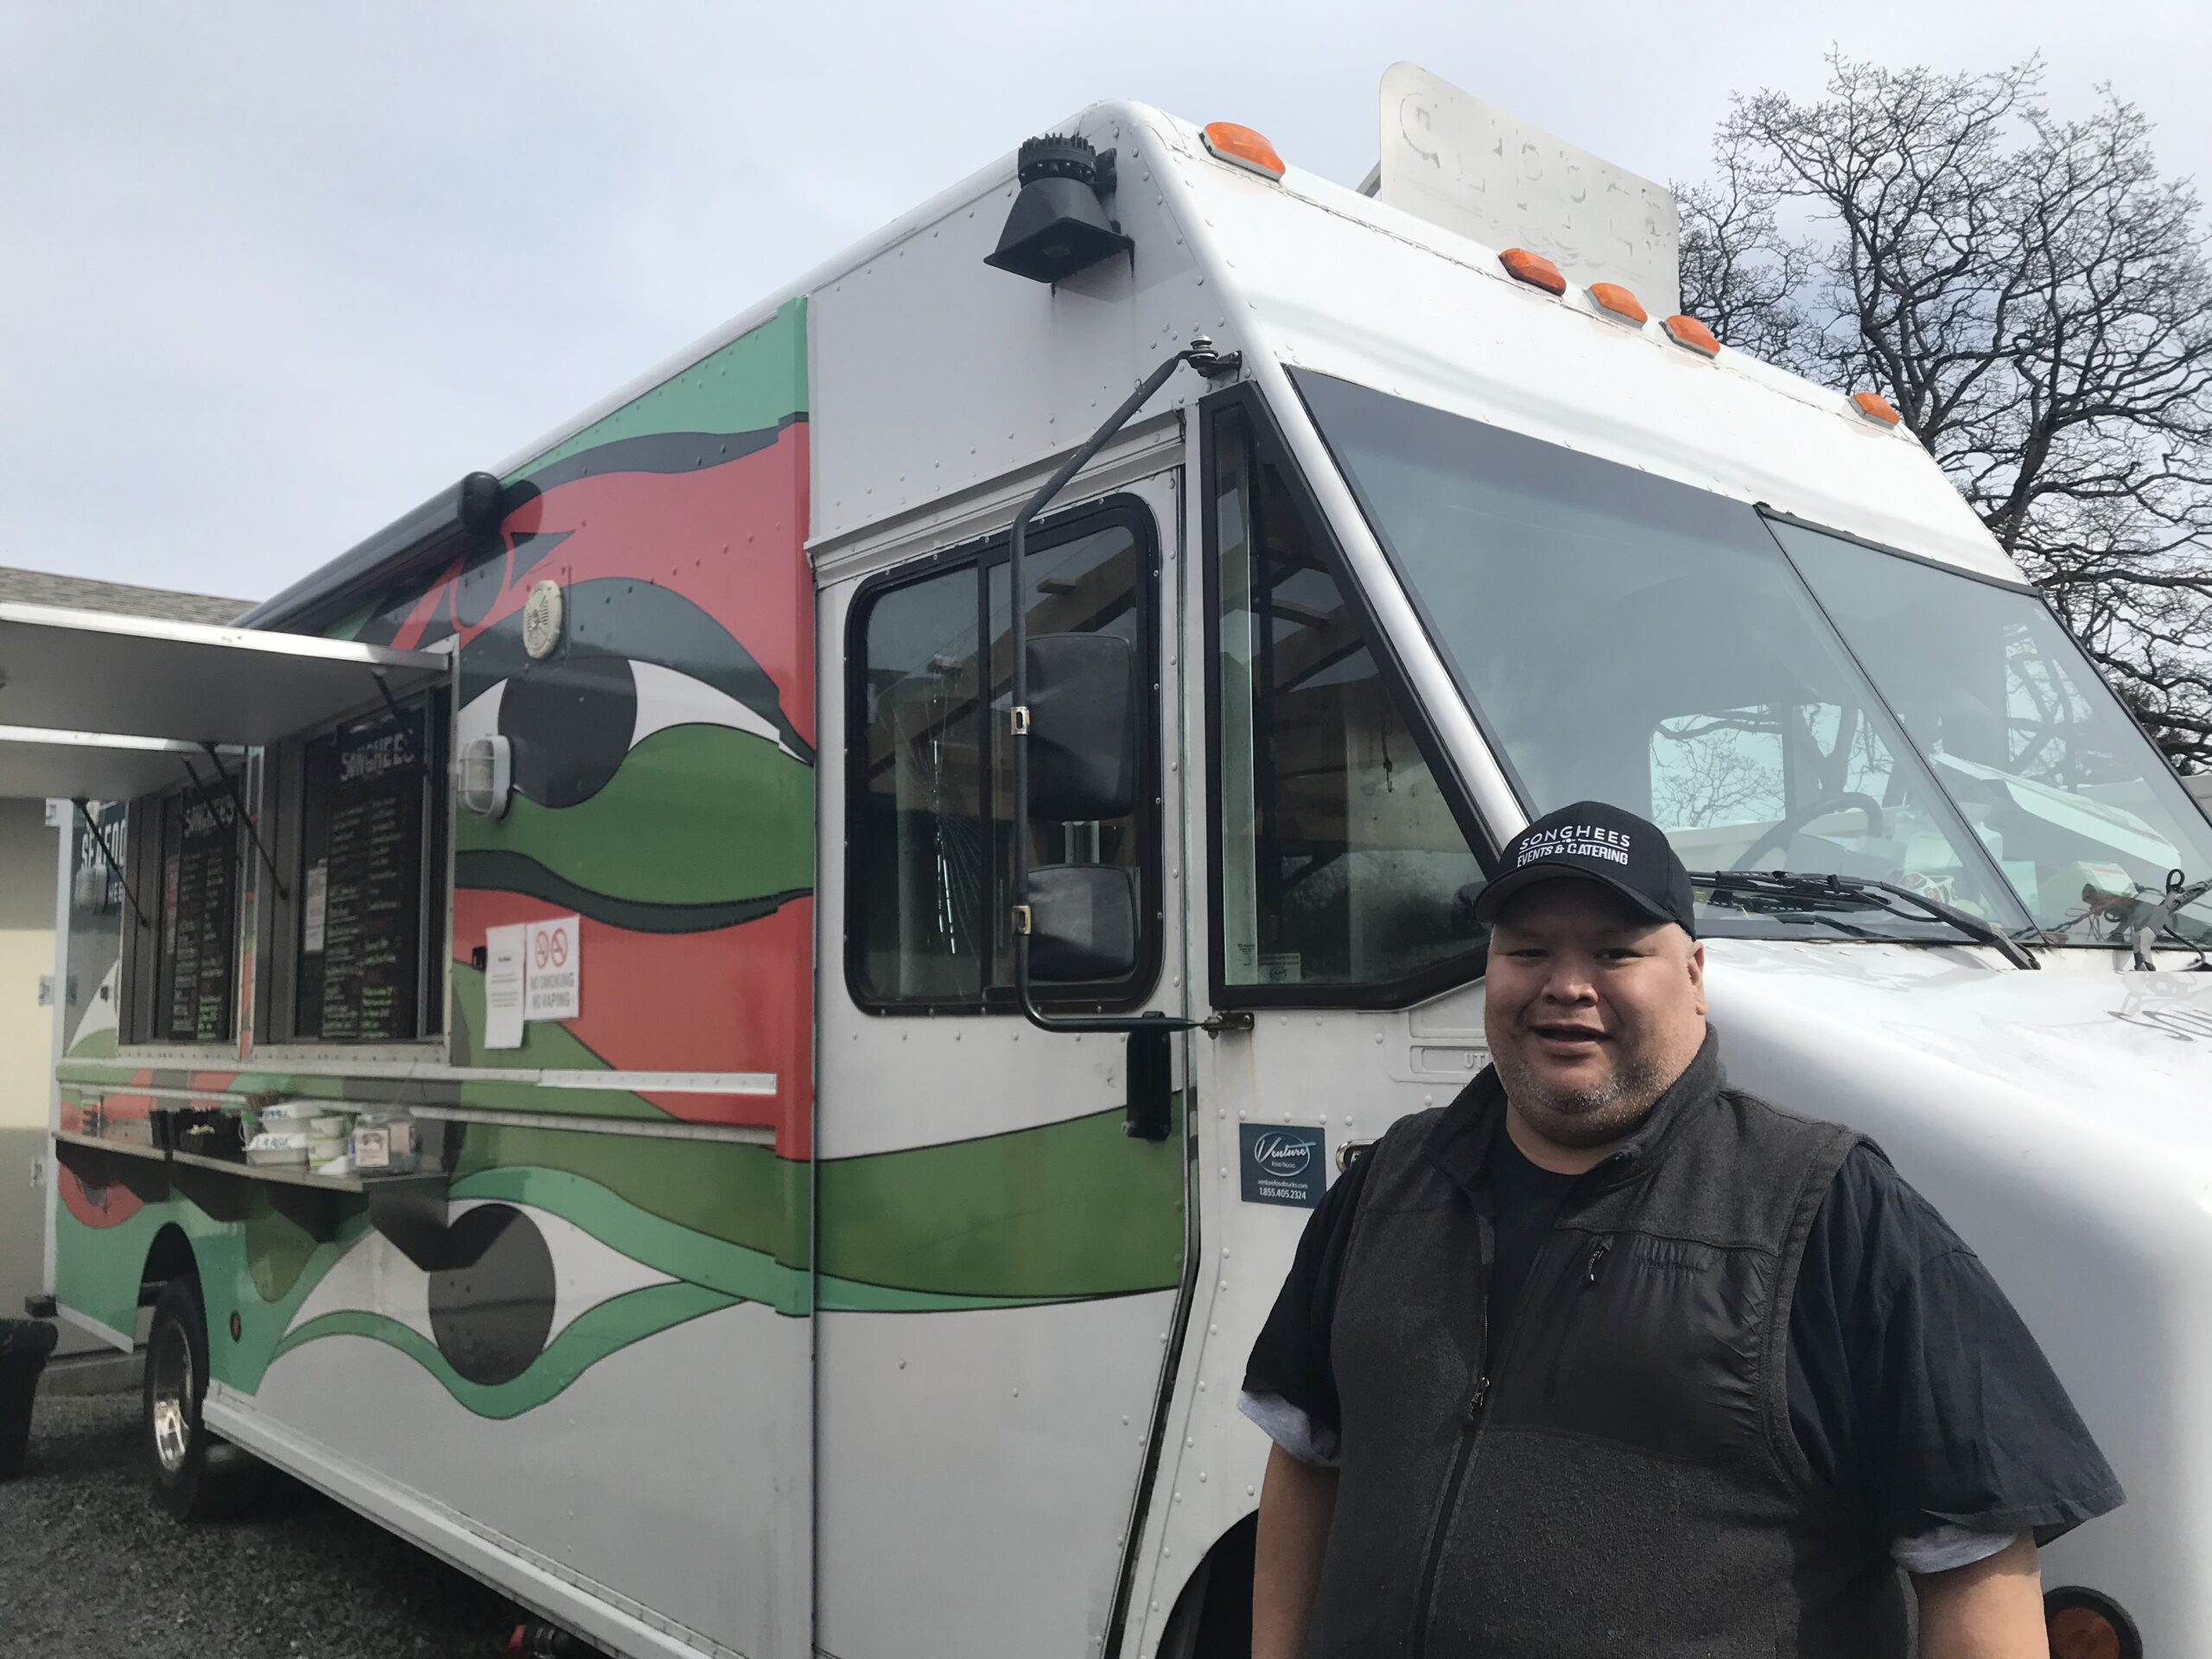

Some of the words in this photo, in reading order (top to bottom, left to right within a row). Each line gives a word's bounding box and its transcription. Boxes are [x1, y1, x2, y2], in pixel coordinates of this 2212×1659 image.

[1520, 825, 1630, 849] SONGHEES
[1517, 844, 1553, 868] EVENTS
[1554, 844, 1565, 854] &
[1567, 843, 1629, 866] CATERING
[1256, 1137, 1316, 1163] Venture
[1259, 1187, 1306, 1200] 1.855.405.2324
